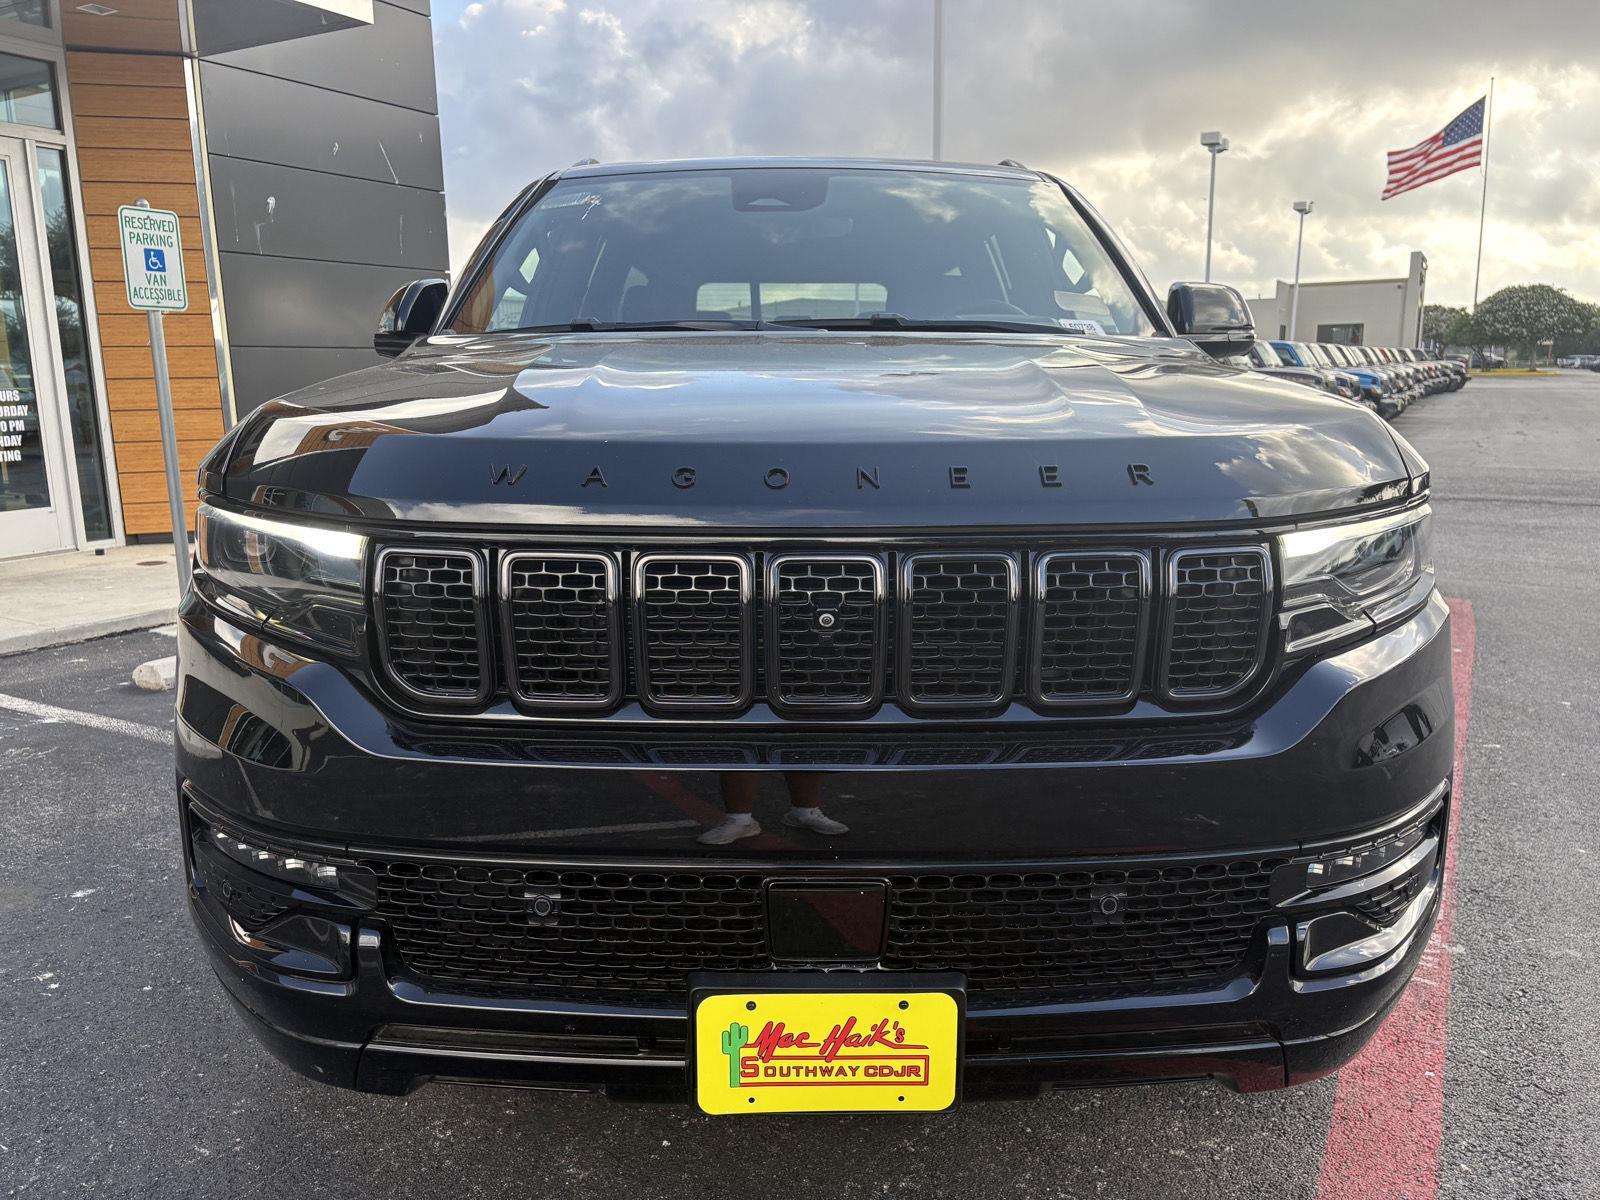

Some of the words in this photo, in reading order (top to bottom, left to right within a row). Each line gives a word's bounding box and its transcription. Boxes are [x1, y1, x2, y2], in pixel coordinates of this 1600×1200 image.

[124, 215, 175, 233] RESERVED
[129, 232, 174, 248] PARKING
[145, 273, 167, 286] VAN
[133, 287, 183, 301] ACCESSIBLE
[0, 390, 20, 402] URS
[9, 420, 25, 431] PM
[489, 463, 1154, 490] WAGONEER
[744, 1020, 821, 1063] Mac
[819, 1016, 928, 1062] Haik's
[740, 1056, 860, 1078] SOUTHWAY
[863, 1065, 922, 1078] CDJR
